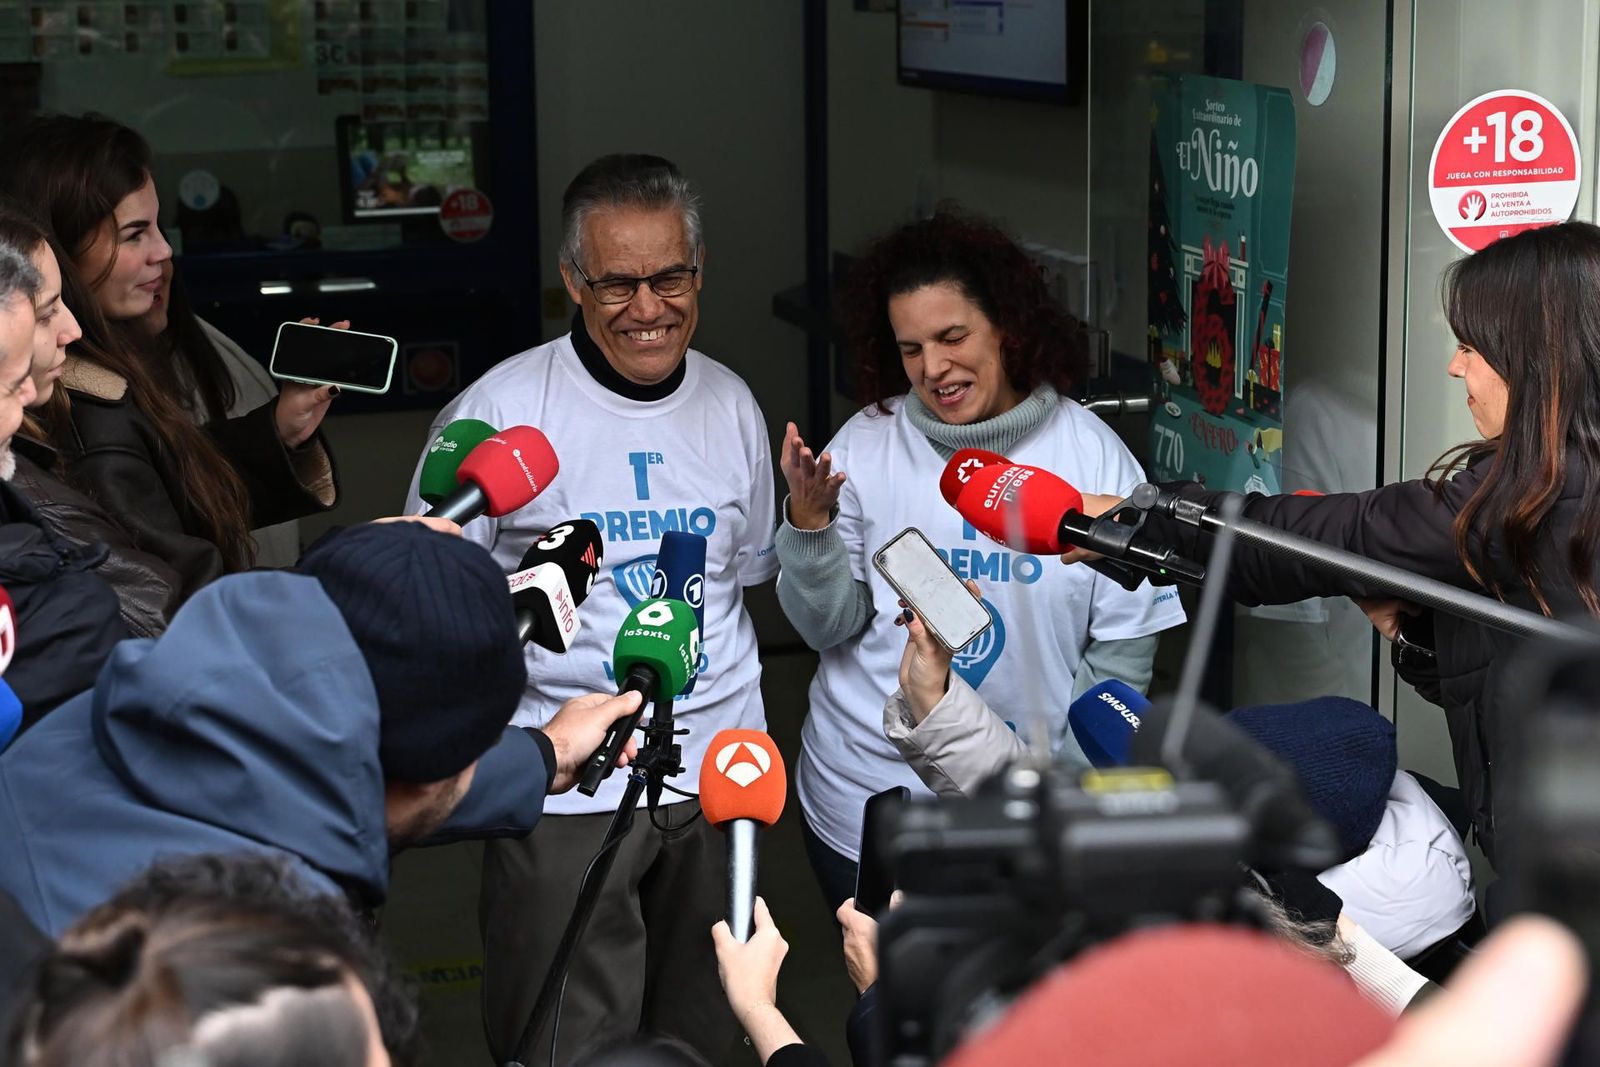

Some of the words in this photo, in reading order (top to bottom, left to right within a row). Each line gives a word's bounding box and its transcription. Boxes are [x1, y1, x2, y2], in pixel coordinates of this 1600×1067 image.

[1192, 107, 1232, 126] Extraordinario
[1234, 114, 1242, 127] de
[1206, 99, 1225, 113] Sorteo
[1463, 110, 1544, 163] +18
[1176, 141, 1191, 171] El
[1191, 127, 1259, 199] Niño
[1446, 171, 1471, 180] JUEGA
[1473, 170, 1490, 179] CON
[1493, 167, 1564, 177] RESPONSABILIDAD
[1491, 191, 1528, 199] PROHIBIDA
[1502, 200, 1524, 208] VENTA
[1490, 207, 1552, 217] AUTOPROHIBIDOS
[1154, 423, 1184, 474] 770
[984, 466, 1020, 508] europa
[1003, 469, 1035, 503] press
[537, 525, 575, 551] 3
[936, 548, 1043, 585] EMIO
[558, 594, 574, 633] info
[624, 628, 671, 641] laSexta
